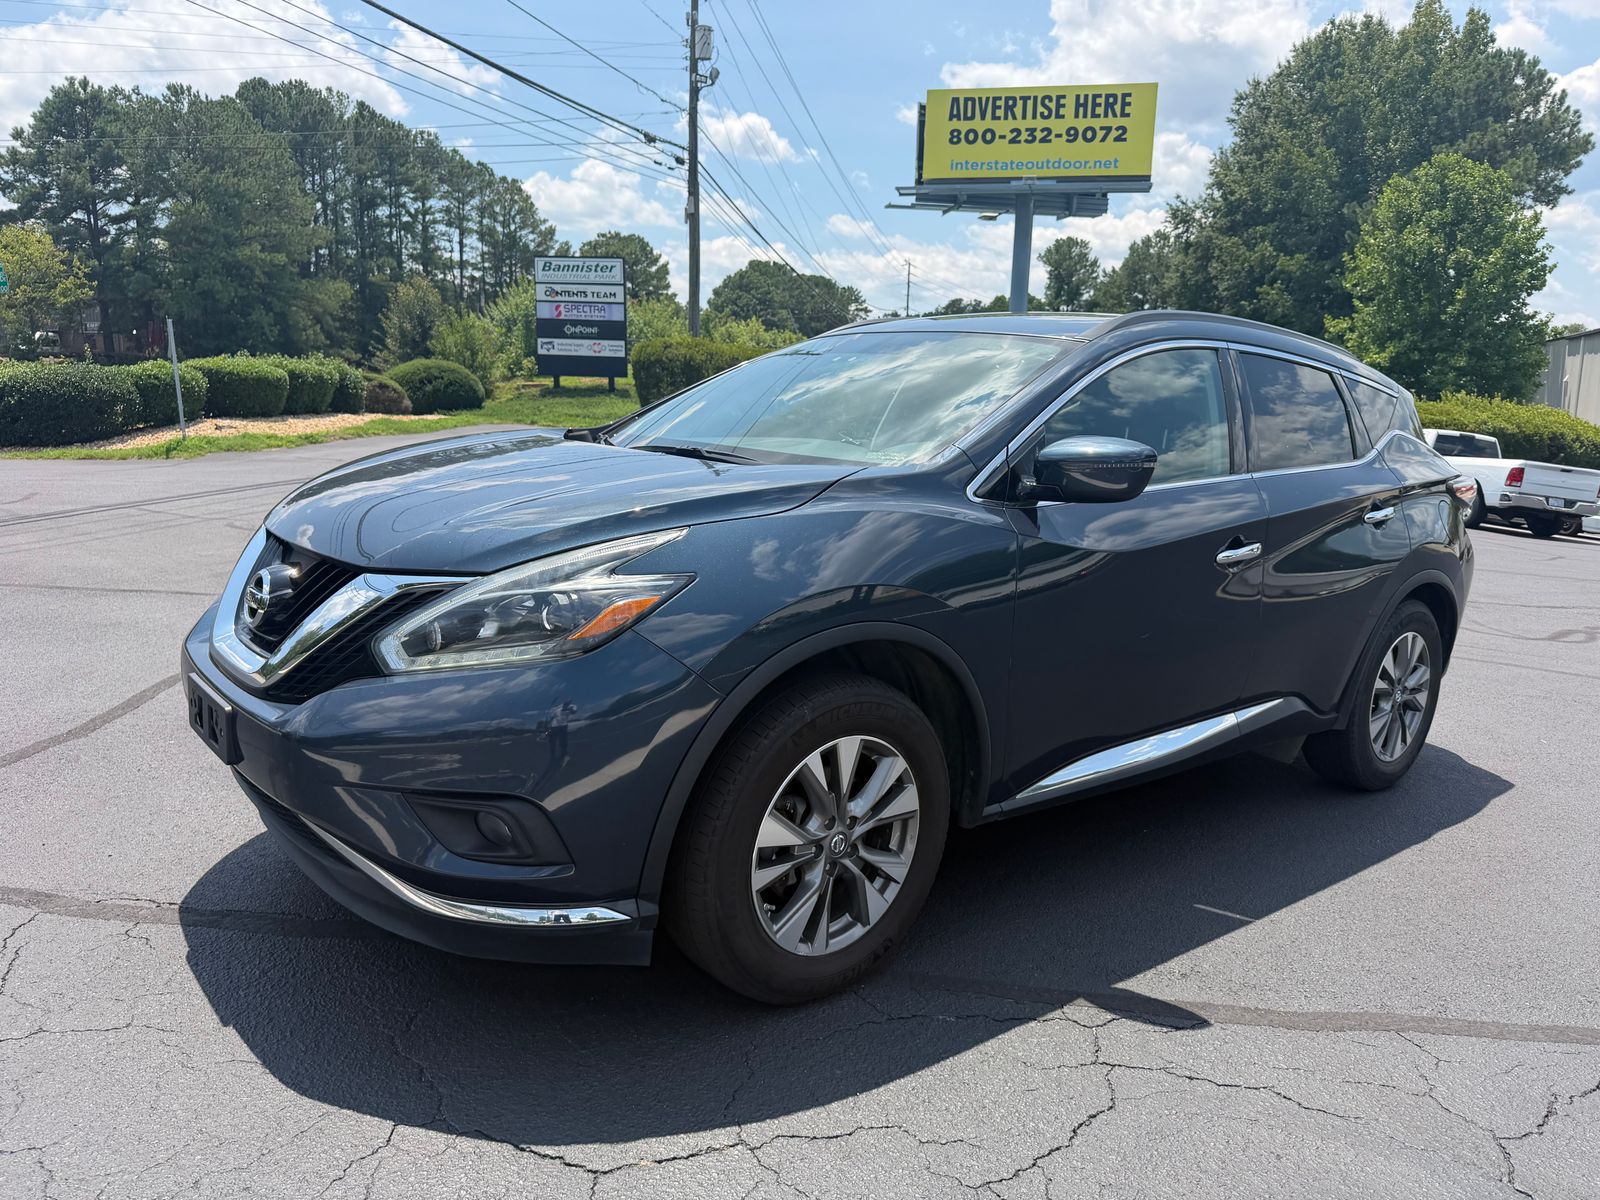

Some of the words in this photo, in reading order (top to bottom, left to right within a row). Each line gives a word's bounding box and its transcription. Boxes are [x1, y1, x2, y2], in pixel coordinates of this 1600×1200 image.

[948, 94, 1067, 121] ADVERTISE
[1074, 92, 1132, 119] HERE
[948, 125, 1128, 145] 800-232-9072
[950, 158, 1119, 171] interstateoutdoor.net
[542, 261, 616, 273] Bannister
[544, 288, 588, 298] CONTENTS
[591, 291, 617, 299] TEAM
[563, 304, 606, 314] SPECTRA
